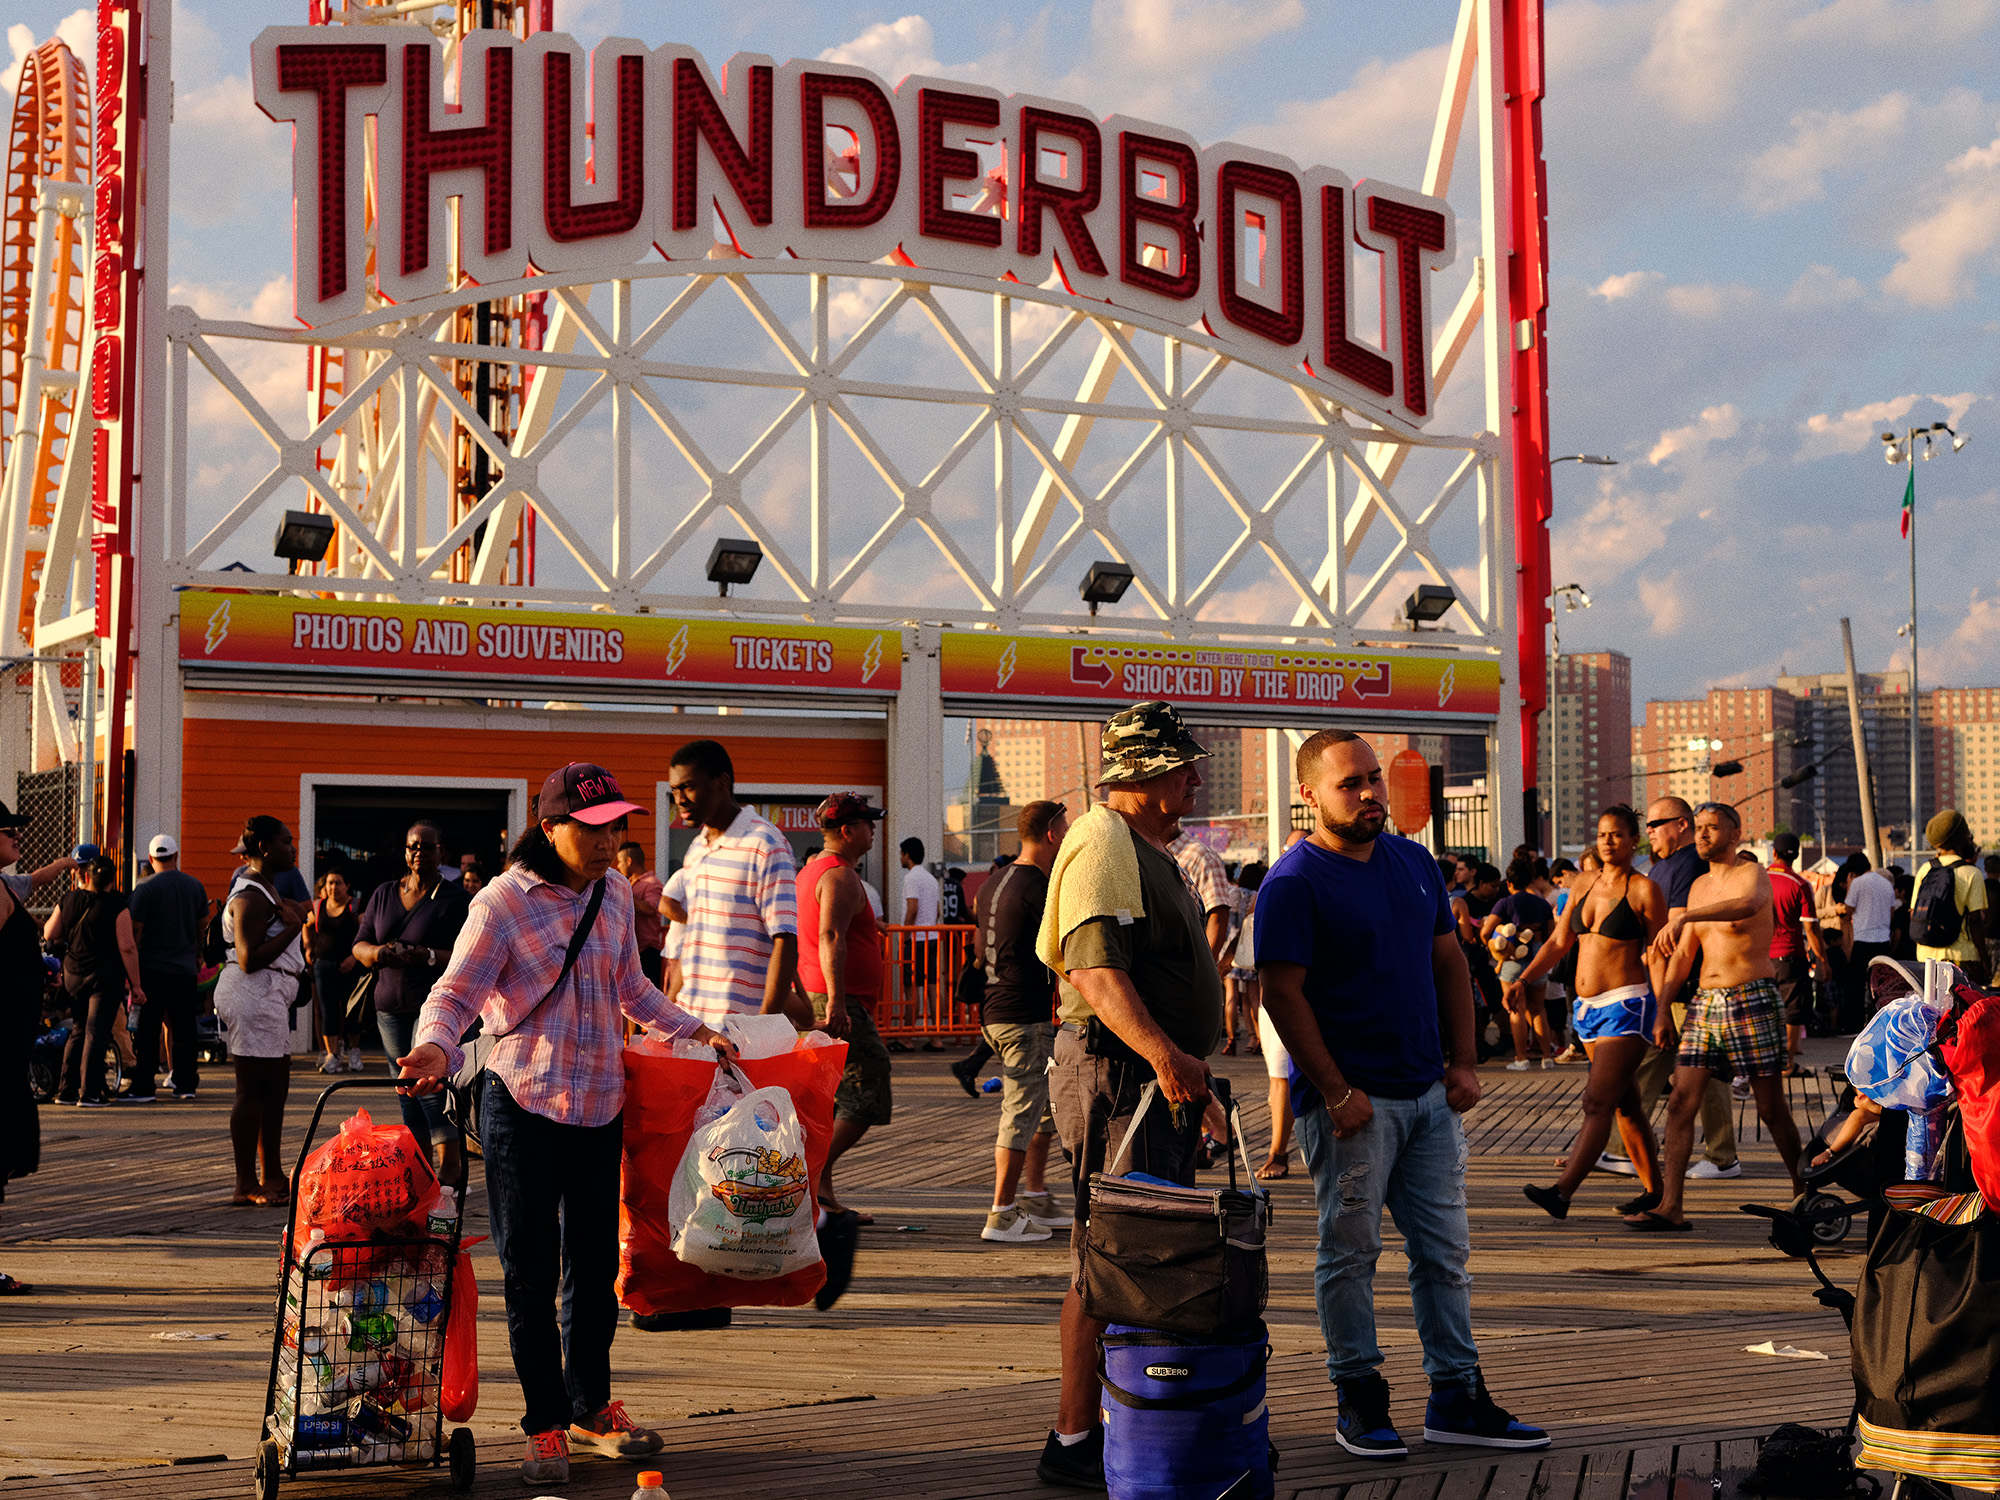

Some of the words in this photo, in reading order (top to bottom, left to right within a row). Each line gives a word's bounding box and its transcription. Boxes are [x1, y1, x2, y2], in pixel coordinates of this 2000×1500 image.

[275, 42, 1446, 417] THUNDERBOLT
[292, 612, 403, 653] PHOTOS
[412, 619, 469, 657] AND
[477, 623, 624, 664] SOUVENIRS
[730, 635, 833, 674] TICKETS
[1195, 651, 1222, 665] ENTER
[1223, 652, 1246, 666] HERE
[1247, 654, 1257, 667] TO
[1258, 654, 1275, 668] GET
[1122, 664, 1218, 697] SHOCKED
[1220, 669, 1244, 698] BY
[1252, 670, 1290, 700] THE
[1295, 671, 1345, 701] DROP
[576, 777, 605, 802] NEW
[782, 806, 821, 829] TICK
[730, 1194, 798, 1216] Nathan's
[303, 1418, 340, 1431] pepsi
